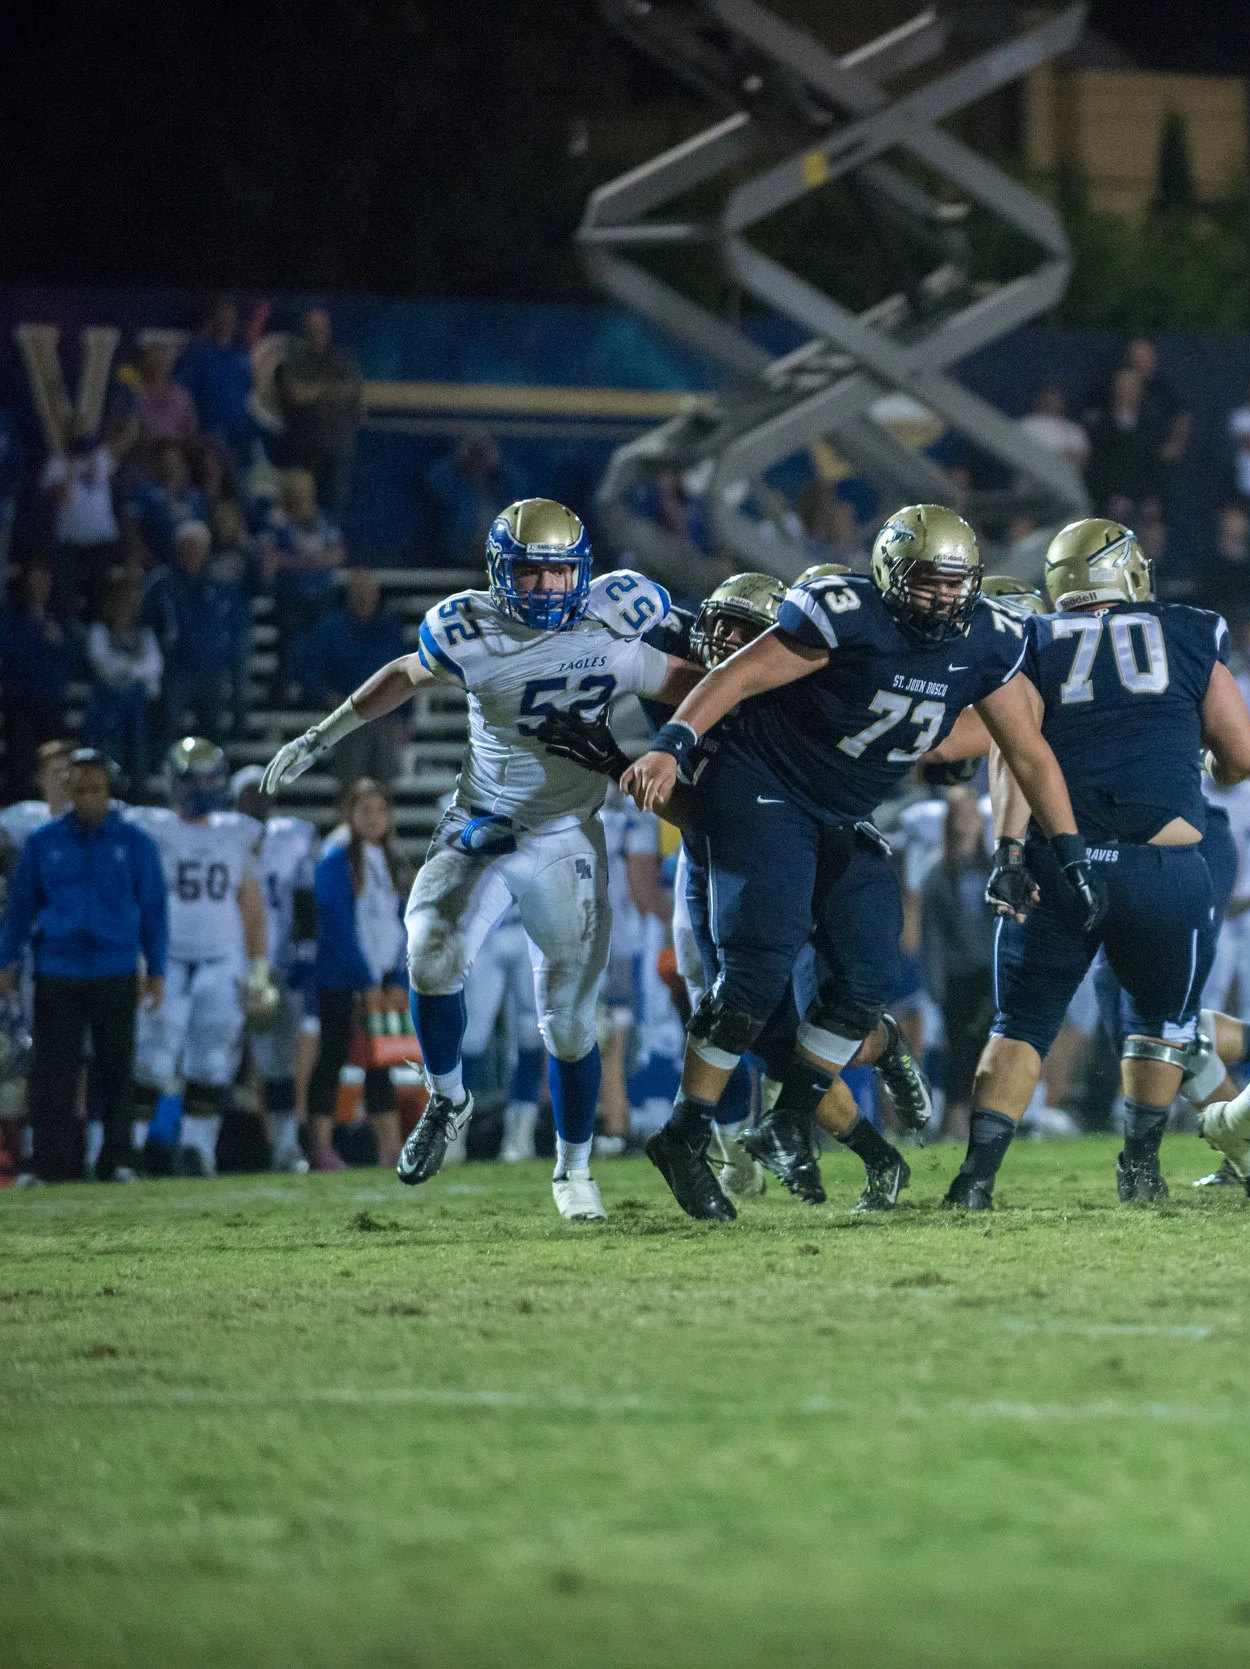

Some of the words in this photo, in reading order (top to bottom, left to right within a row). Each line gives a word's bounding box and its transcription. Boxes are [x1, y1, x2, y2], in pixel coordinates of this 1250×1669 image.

[437, 597, 482, 648] 52
[604, 574, 657, 633] 52
[560, 655, 608, 672] EAGLES
[1052, 612, 1170, 704] 70
[905, 678, 927, 694] JOHN
[925, 682, 949, 698] BOSCO
[835, 688, 947, 763] 73
[1085, 847, 1120, 863] RAVES
